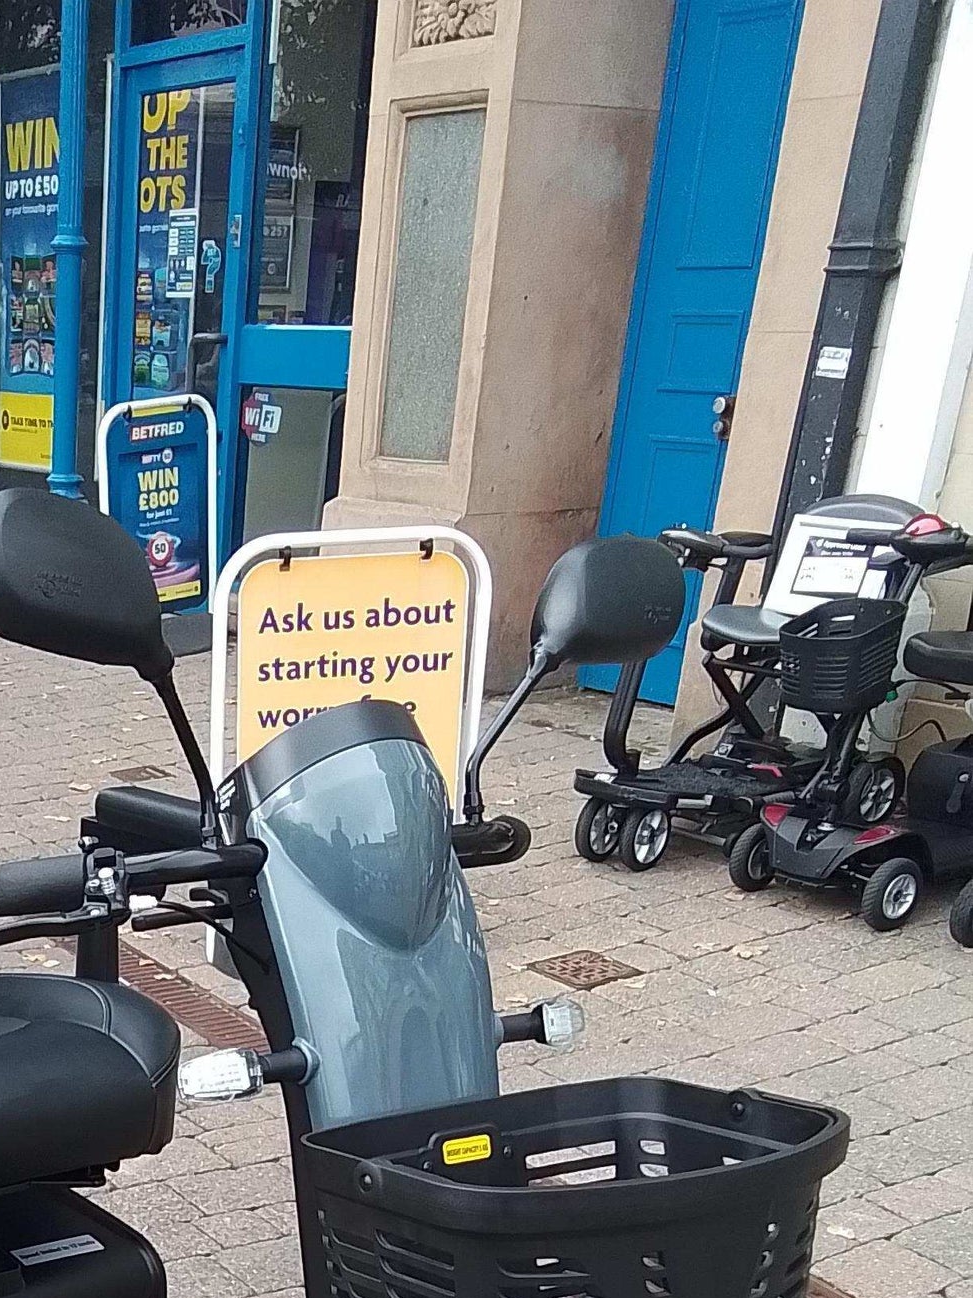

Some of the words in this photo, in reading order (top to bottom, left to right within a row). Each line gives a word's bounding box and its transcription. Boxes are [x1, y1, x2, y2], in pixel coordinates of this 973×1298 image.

[147, 135, 189, 171] THE
[5, 180, 19, 200] UP
[20, 178, 34, 198] TO
[140, 175, 186, 213] OTS
[131, 421, 184, 441] BETFRED
[137, 466, 179, 492] WIN
[138, 488, 179, 511] £800
[154, 543, 166, 555] 50
[258, 602, 313, 634] Ask
[323, 609, 355, 630] us
[365, 597, 456, 628] about
[258, 651, 375, 684] starting
[384, 652, 454, 683] your
